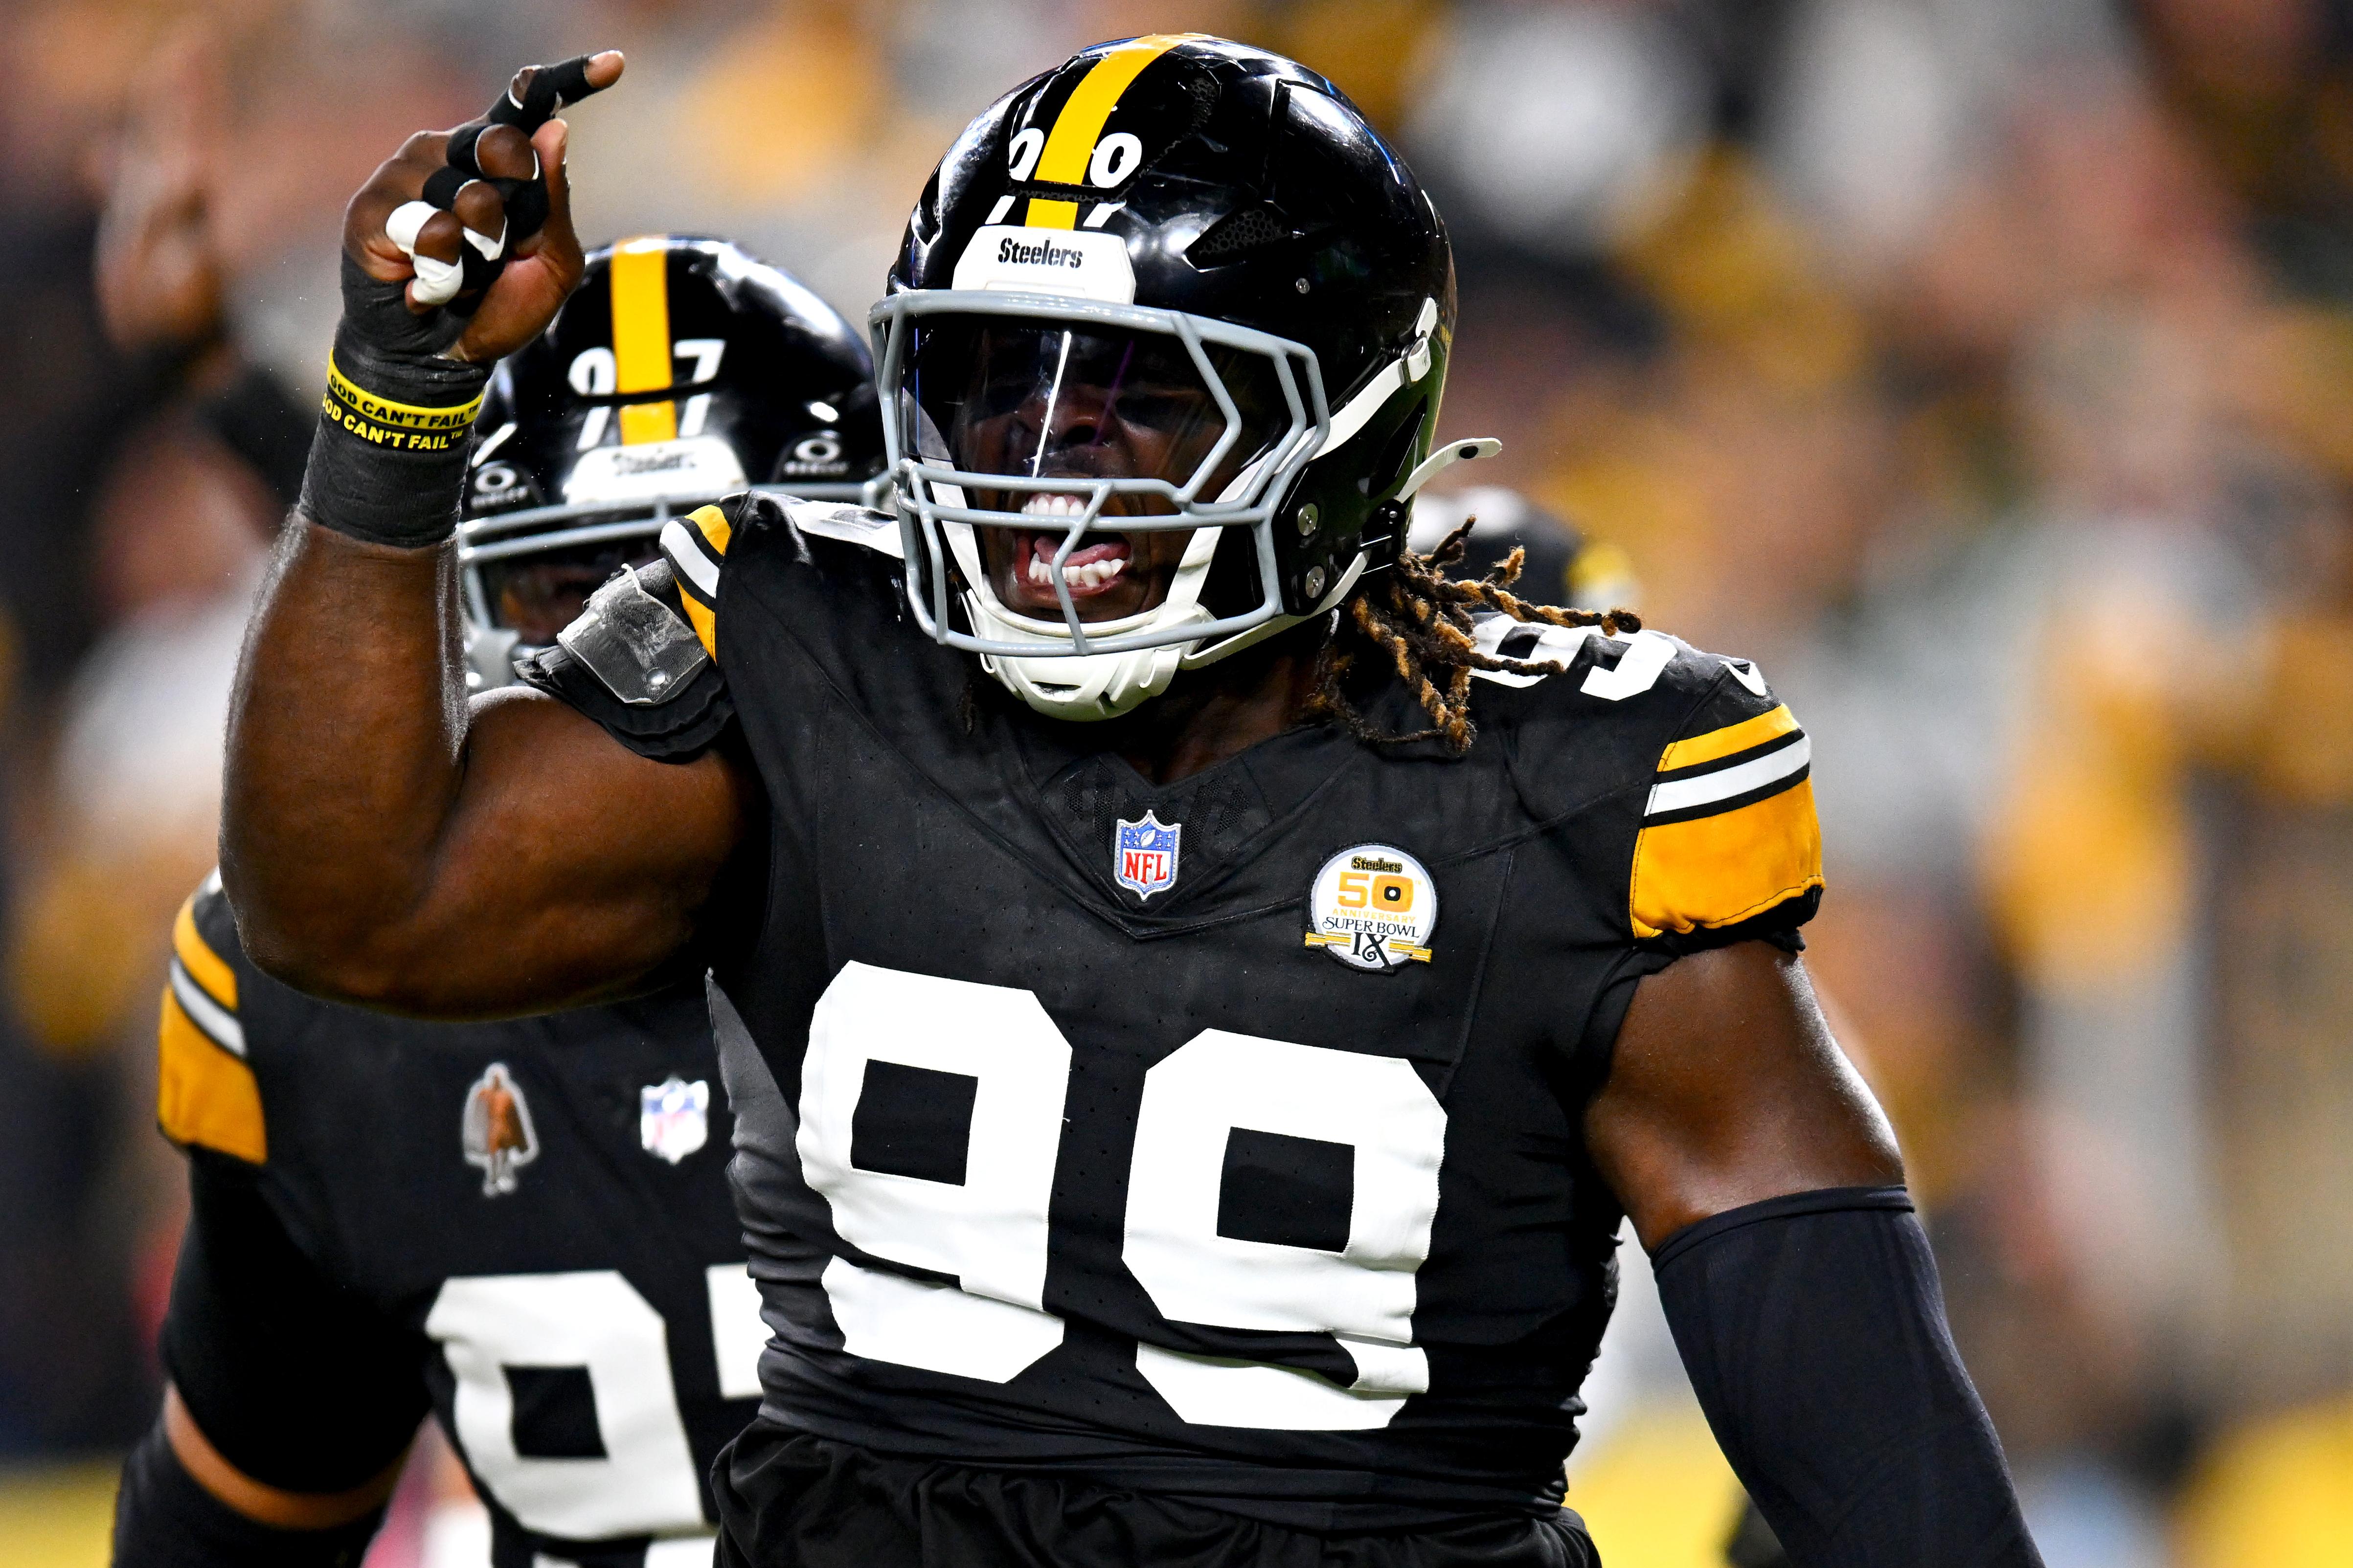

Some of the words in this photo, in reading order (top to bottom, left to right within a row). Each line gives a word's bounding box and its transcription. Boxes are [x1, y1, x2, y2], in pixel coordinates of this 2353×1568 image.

[998, 237, 1083, 269] Steelers
[331, 375, 358, 405] GOD
[362, 401, 425, 426] CAN'T
[428, 413, 466, 426] FAIL
[344, 414, 405, 447] CAN'T
[408, 434, 449, 449] FAIL
[1124, 852, 1167, 884] NFL
[1351, 856, 1403, 874] Steelers
[1337, 872, 1414, 913] 50
[1322, 917, 1373, 932] SUPER
[1377, 920, 1420, 938] BOWL
[1332, 908, 1416, 924] ANNIVERSARY
[1351, 932, 1393, 968] IX
[795, 960, 1448, 1431] 99
